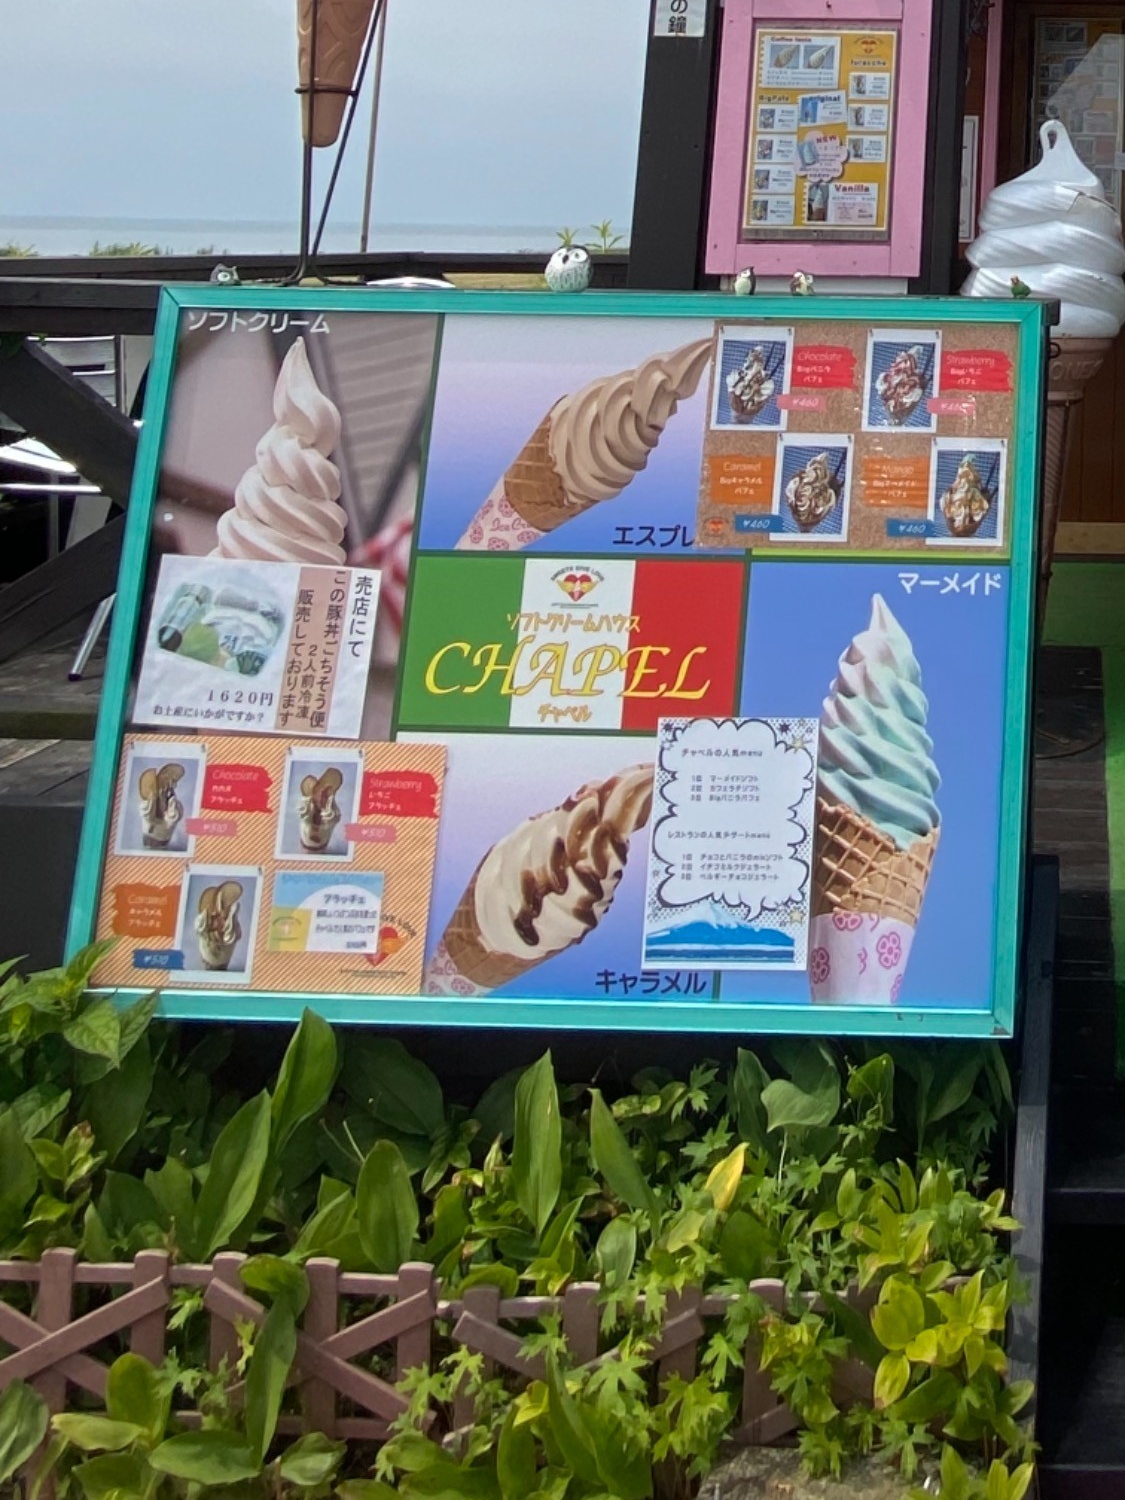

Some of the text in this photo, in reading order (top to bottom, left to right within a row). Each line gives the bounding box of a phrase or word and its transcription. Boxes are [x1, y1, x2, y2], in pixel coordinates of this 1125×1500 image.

[834, 184, 870, 193] Vanilla
[188, 311, 330, 334] ソフトクリーム
[797, 350, 843, 362] Chocolate
[946, 354, 995, 368] Strawberry
[723, 461, 762, 471] Caramel
[612, 524, 696, 548] エスプレ
[898, 572, 1001, 596] マーメイド
[347, 575, 373, 658] 売店にて
[506, 612, 641, 633] ソフトクリームハウス
[279, 589, 315, 727] 販売しております
[309, 570, 348, 729] この豚丼ごちそう便
[423, 634, 711, 700] CHAPEL
[207, 690, 274, 707] 1620円
[212, 769, 259, 780] Chocolate
[370, 777, 422, 792] Strawberry
[595, 968, 707, 995] キャラメル
